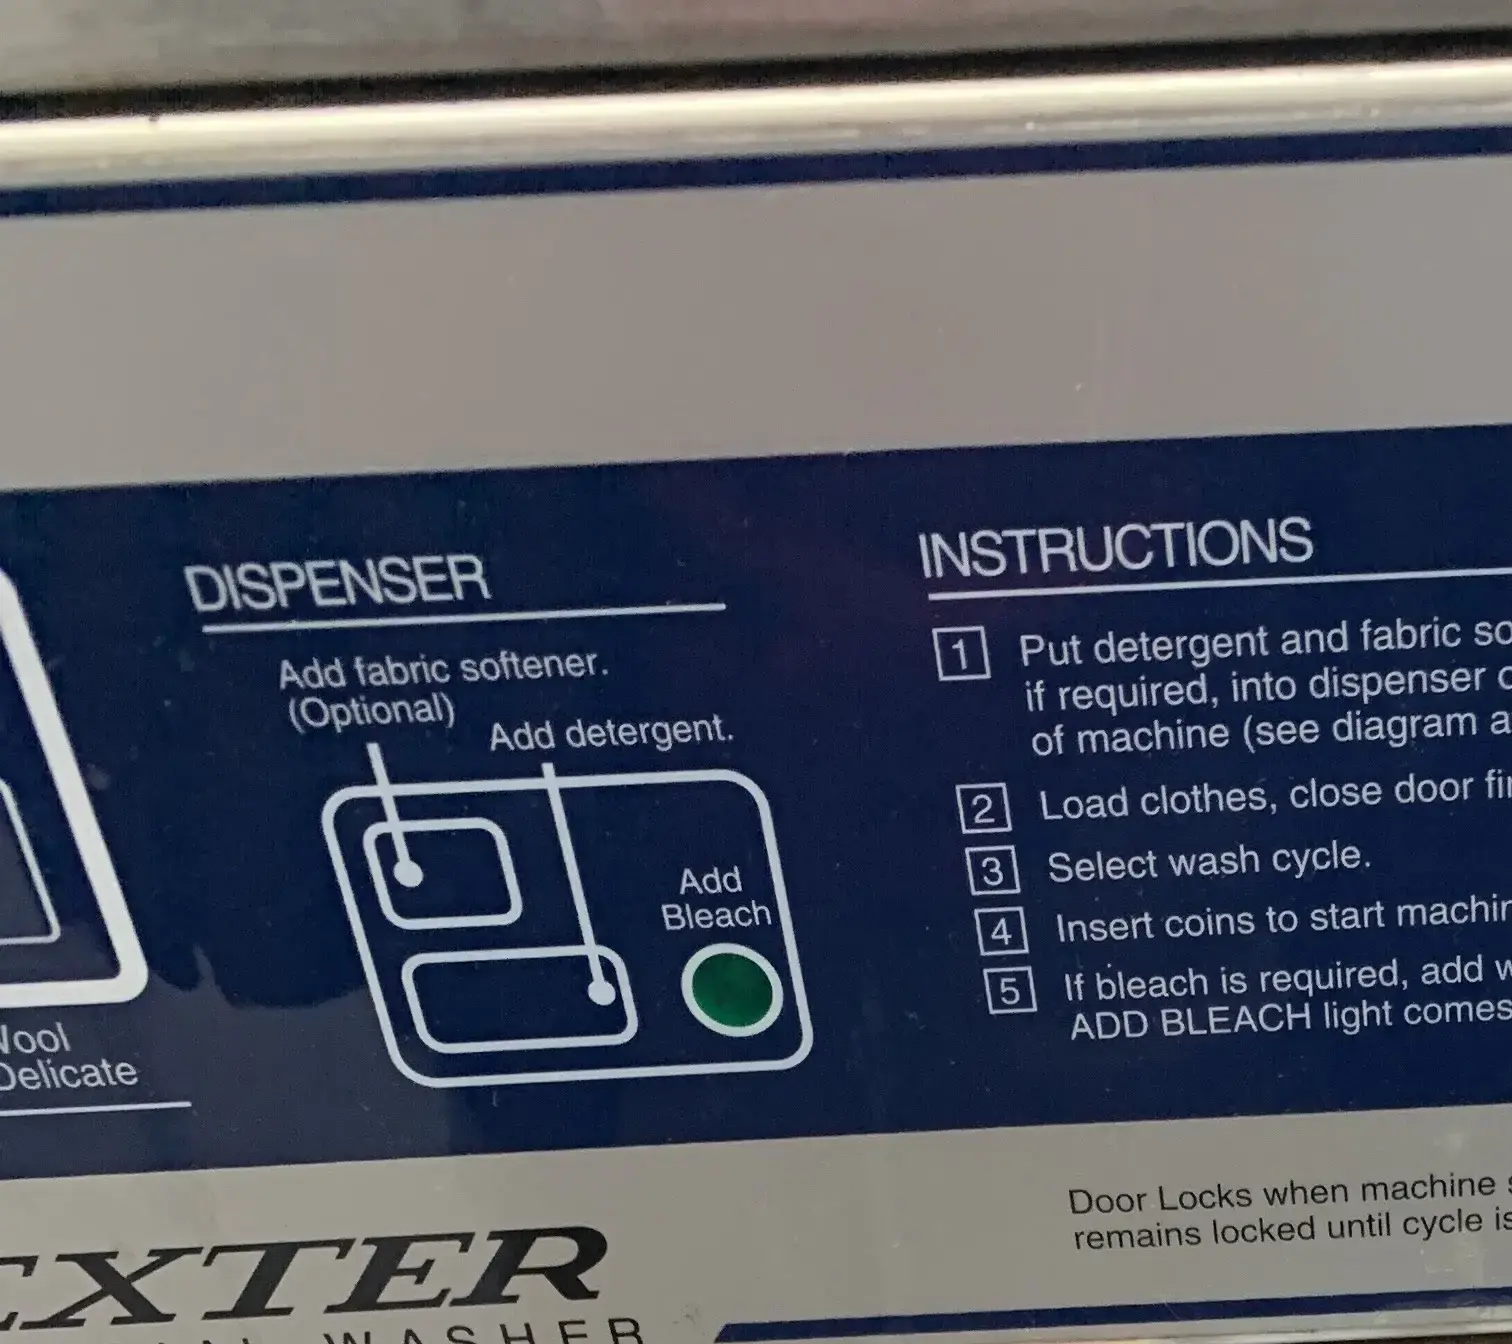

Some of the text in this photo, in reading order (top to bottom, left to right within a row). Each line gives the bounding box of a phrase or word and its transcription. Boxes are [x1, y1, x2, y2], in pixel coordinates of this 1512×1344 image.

[918, 516, 1313, 578] INSTRUCTIONS
[184, 554, 491, 614] DISPENSER
[951, 640, 968, 670] 1
[1020, 635, 1081, 668] Put
[1093, 628, 1268, 669] detergent
[1282, 621, 1348, 655] and
[1359, 617, 1461, 652] fabric
[279, 649, 609, 690] Add fabric softener.
[1025, 679, 1049, 712] if
[1058, 676, 1219, 717] required,
[1231, 671, 1297, 704] into
[1309, 664, 1486, 710] dispenser
[289, 694, 456, 734] (Optional)
[489, 715, 734, 753] Add detergent.
[1031, 726, 1066, 757] of
[1077, 717, 1231, 755] machine
[1243, 712, 1319, 753] (see
[1332, 707, 1478, 748] diagram
[973, 795, 994, 823] 2
[1040, 787, 1128, 821] Load
[1141, 779, 1278, 817] clothes,
[1290, 775, 1383, 809] close
[1394, 772, 1473, 803] door
[679, 866, 743, 895] Add
[982, 840, 1371, 886] 3 Select wash cycle.
[661, 900, 772, 931] Bleach
[991, 919, 1011, 946] 4
[1057, 913, 1153, 943] Insert
[1164, 905, 1256, 938] coins
[1266, 905, 1298, 933] to
[1309, 900, 1385, 931] start
[1000, 978, 1021, 1006] 5
[1064, 971, 1084, 1002] If
[1096, 964, 1209, 1000] bleach
[1219, 964, 1247, 993] is
[1259, 956, 1409, 997] required,
[1421, 955, 1482, 985] add
[1070, 1009, 1147, 1041] ADD
[1162, 1002, 1311, 1037] BLEACH
[1323, 998, 1393, 1036] light
[1067, 1187, 1148, 1216] Door
[1157, 1182, 1254, 1212] Locks
[1262, 1177, 1349, 1207] when
[1360, 1172, 1497, 1203] machine
[1073, 1220, 1202, 1251] remains
[1211, 1215, 1316, 1244] locked
[1327, 1211, 1392, 1240] until
[1402, 1207, 1484, 1242] cycle
